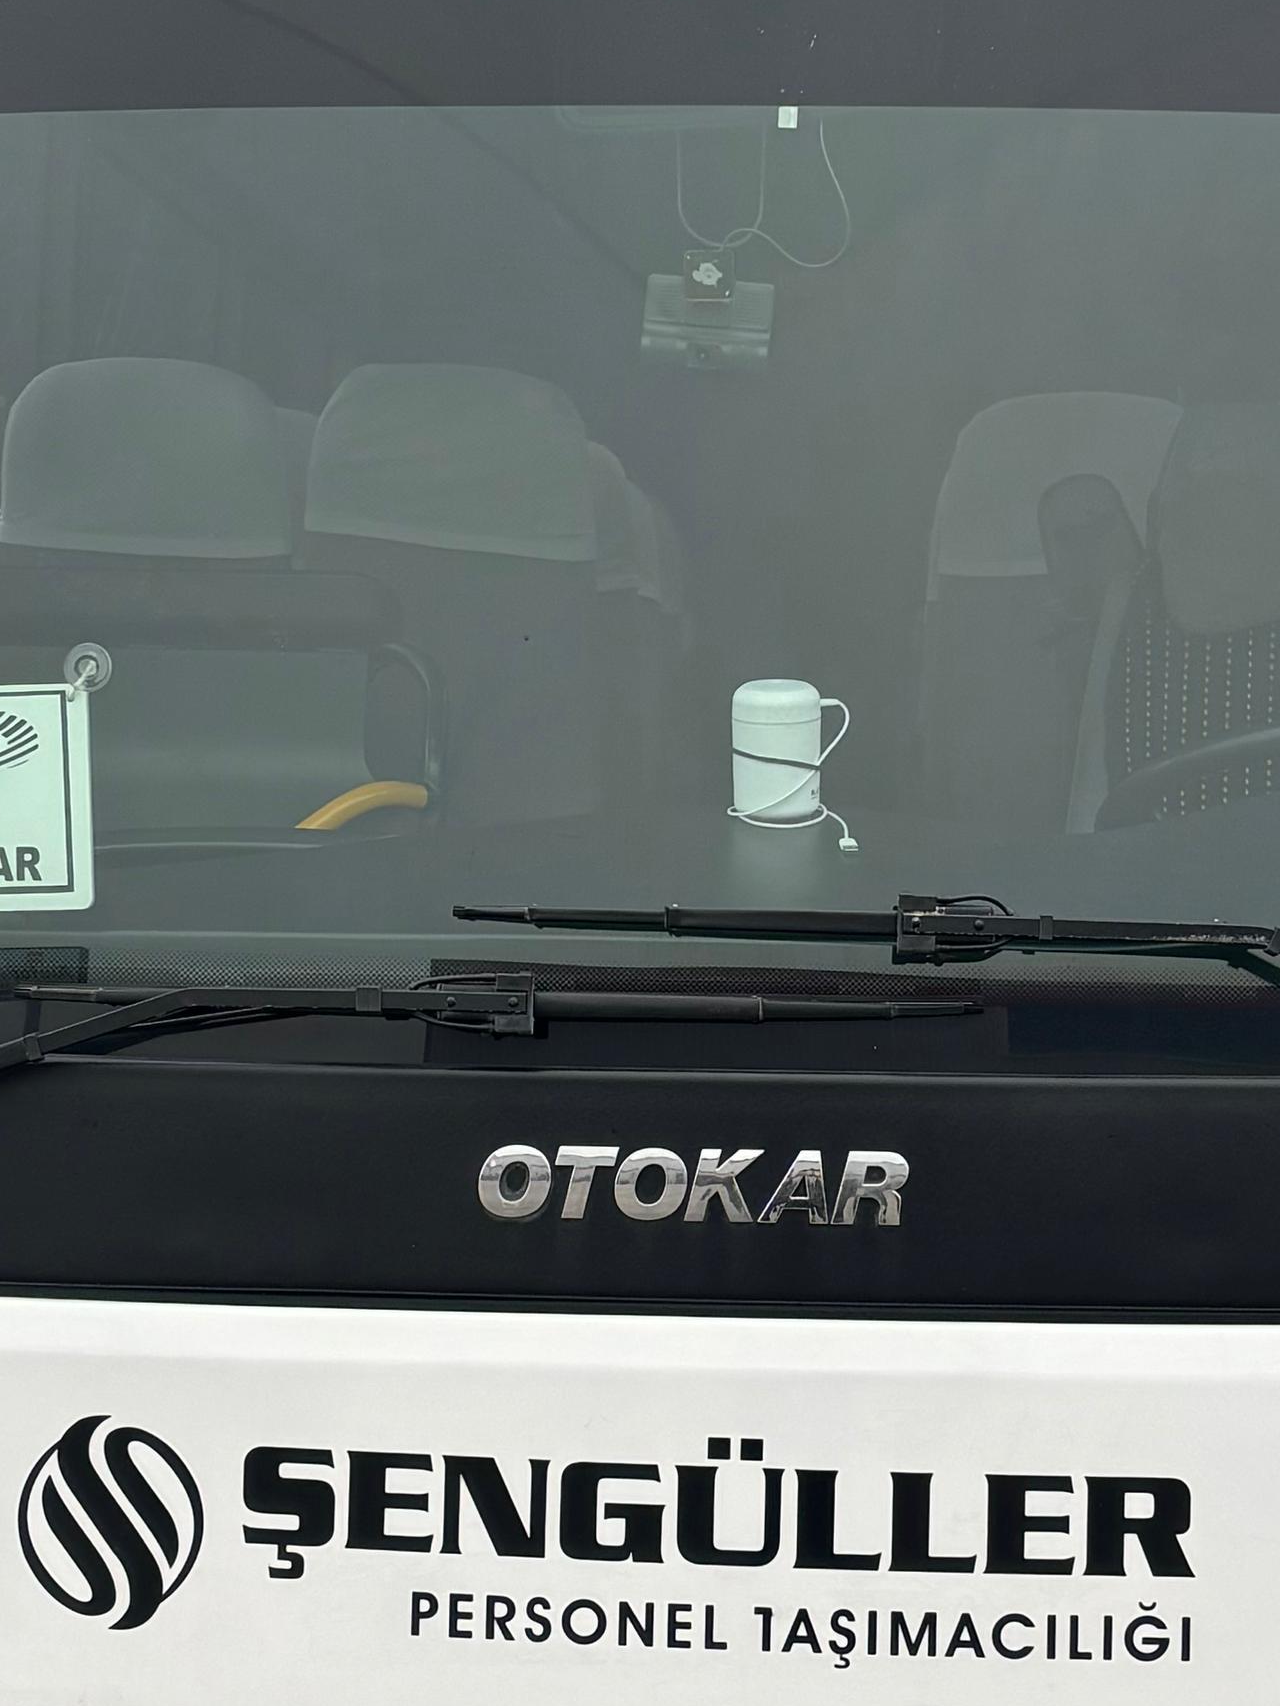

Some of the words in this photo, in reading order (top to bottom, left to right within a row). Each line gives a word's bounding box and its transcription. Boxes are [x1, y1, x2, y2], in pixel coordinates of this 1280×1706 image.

[477, 1144, 910, 1227] OTOKAR
[242, 1437, 1196, 1580] ŞENGÜLLER
[410, 1591, 728, 1650] PERSONEL
